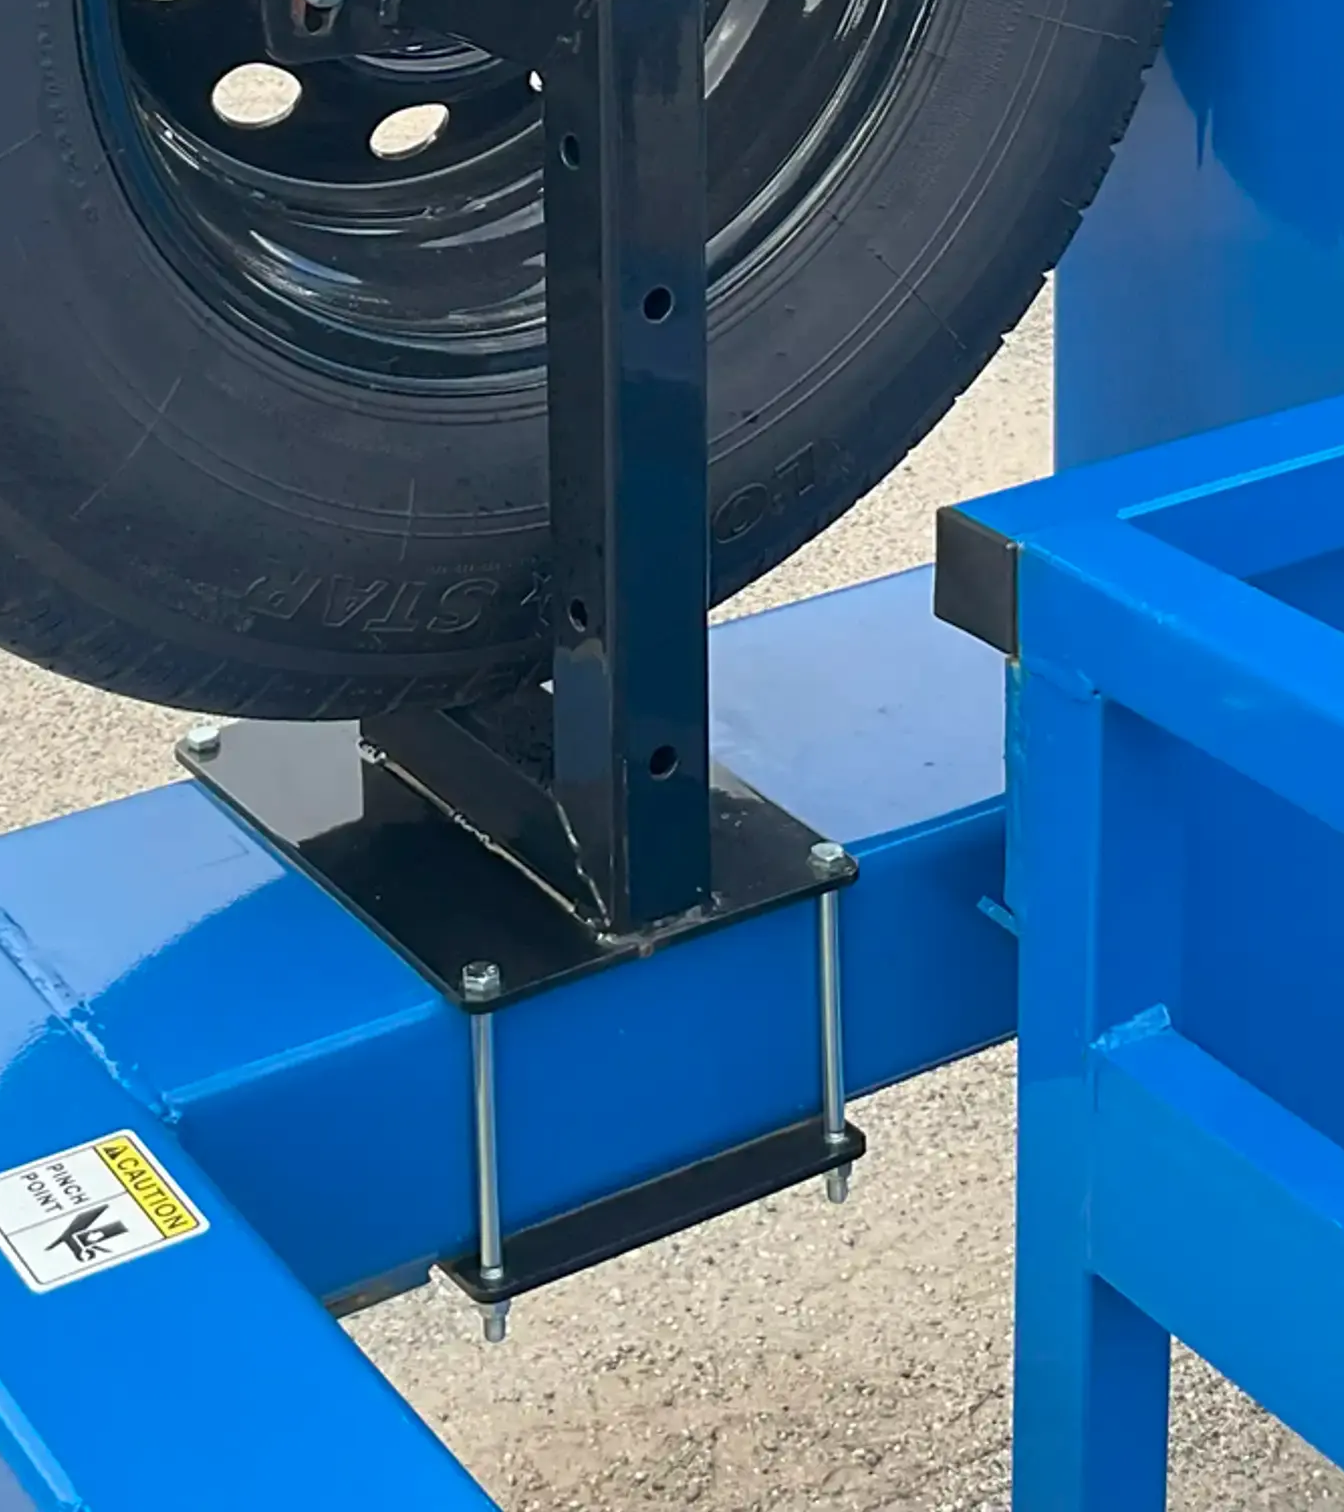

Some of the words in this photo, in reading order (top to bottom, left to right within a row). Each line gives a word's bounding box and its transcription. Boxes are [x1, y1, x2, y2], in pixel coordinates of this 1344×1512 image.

[20, 1171, 66, 1214] POINT
[45, 1162, 92, 1206] PINCH
[117, 1154, 190, 1232] CAUTION
